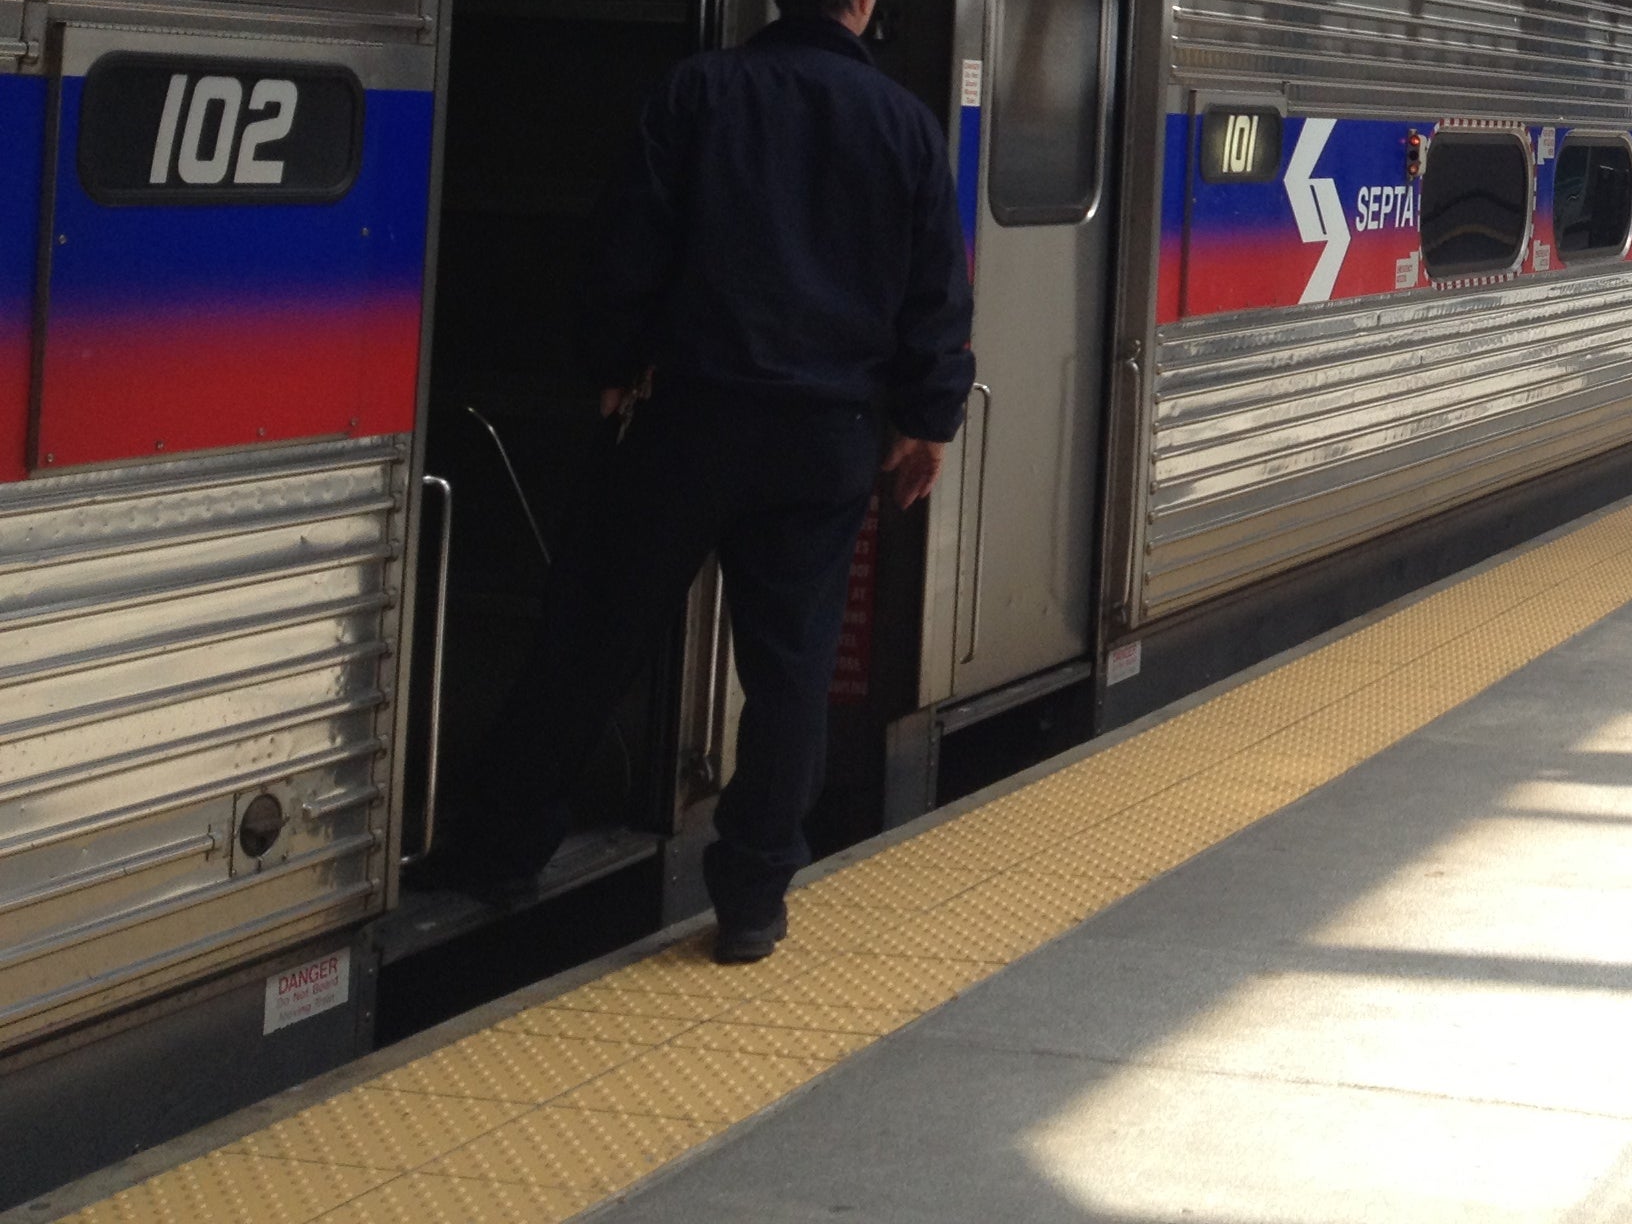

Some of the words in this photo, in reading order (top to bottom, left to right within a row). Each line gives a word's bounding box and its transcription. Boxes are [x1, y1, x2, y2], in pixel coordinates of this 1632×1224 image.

[149, 74, 298, 184] 102
[1222, 115, 1259, 173] 101
[1355, 185, 1414, 232] SEPTA
[278, 957, 339, 995] DANGER
